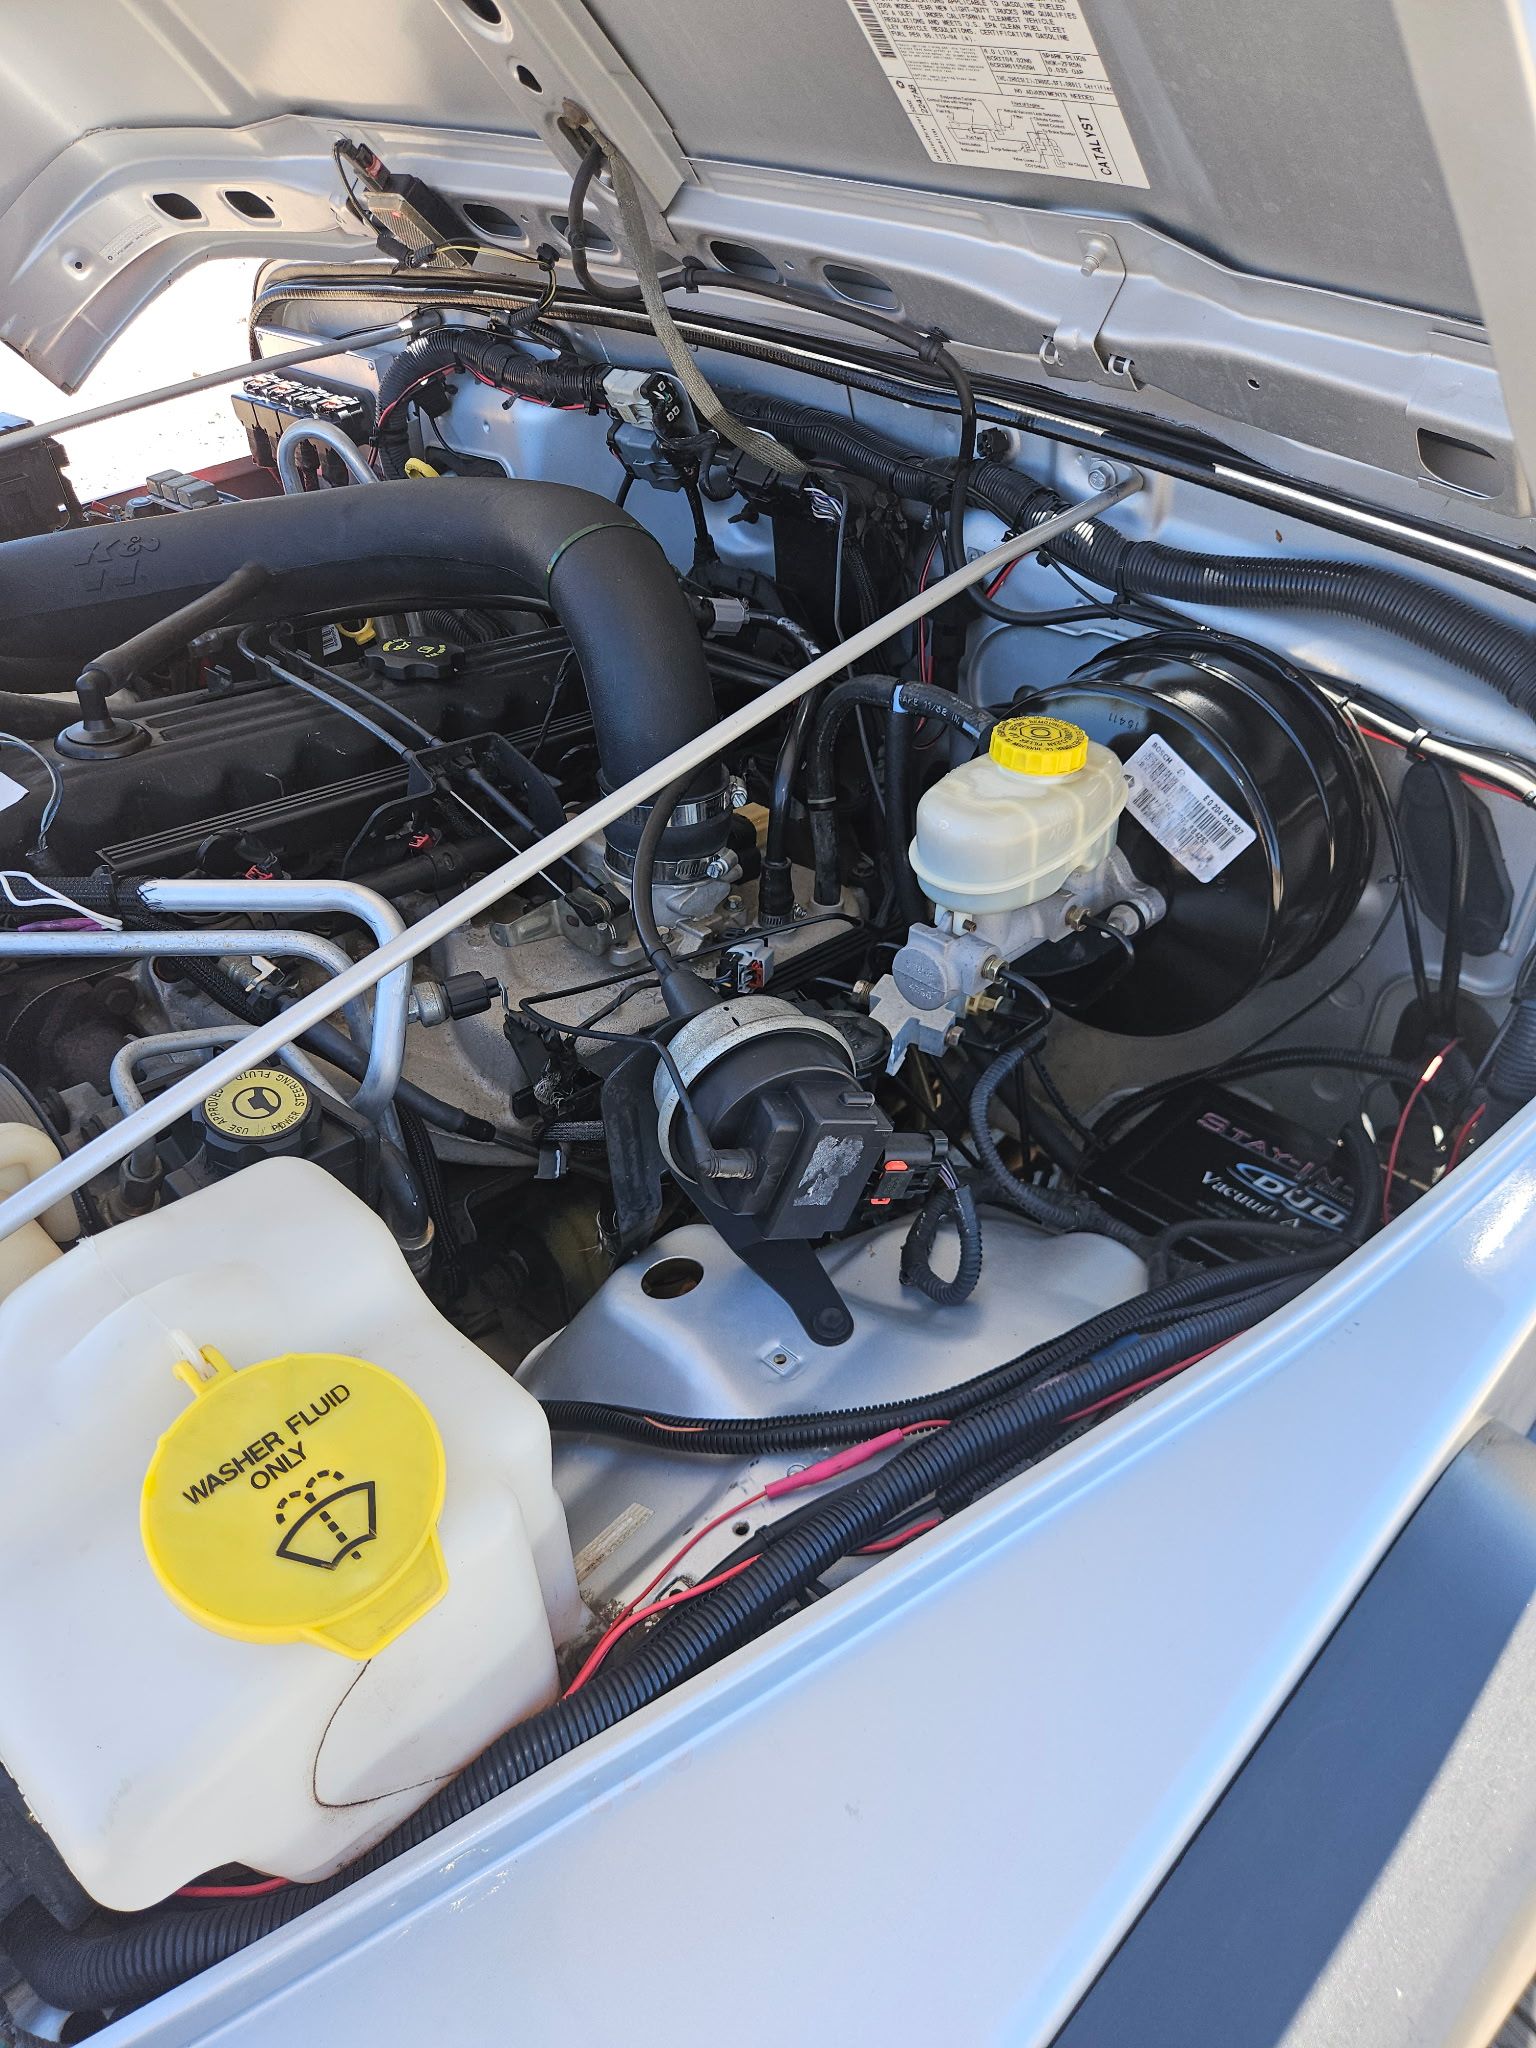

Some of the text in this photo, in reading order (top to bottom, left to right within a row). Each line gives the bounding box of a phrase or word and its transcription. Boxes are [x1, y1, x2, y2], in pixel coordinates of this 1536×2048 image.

[1000, 0, 1036, 8] GASOLINE
[1038, 2, 1065, 10] FUELED
[883, 16, 925, 24] REGULATIONS
[945, 13, 986, 21] CALIFORNIA
[988, 15, 1021, 23] CLEANEST
[1024, 17, 1055, 25] VEHICLE
[1037, 10, 1077, 18] QUALIFIES
[979, 29, 1032, 38] CERTIFICATION
[1034, 33, 1069, 41] GASOLINE
[1041, 52, 1063, 60] SPARK
[1025, 89, 1067, 98] ADJUSTMENTS
[1077, 115, 1112, 176] CATALYST
[1152, 742, 1173, 764] BOSCH
[1202, 794, 1210, 802] E
[1211, 804, 1222, 817] 204
[1232, 823, 1245, 836] 507
[236, 1070, 305, 1132] POWER STEERING FLUID
[207, 1087, 249, 1135] USE APPROVED
[182, 1384, 351, 1505] WASHER FLUID
[250, 1441, 307, 1490] ONLY
